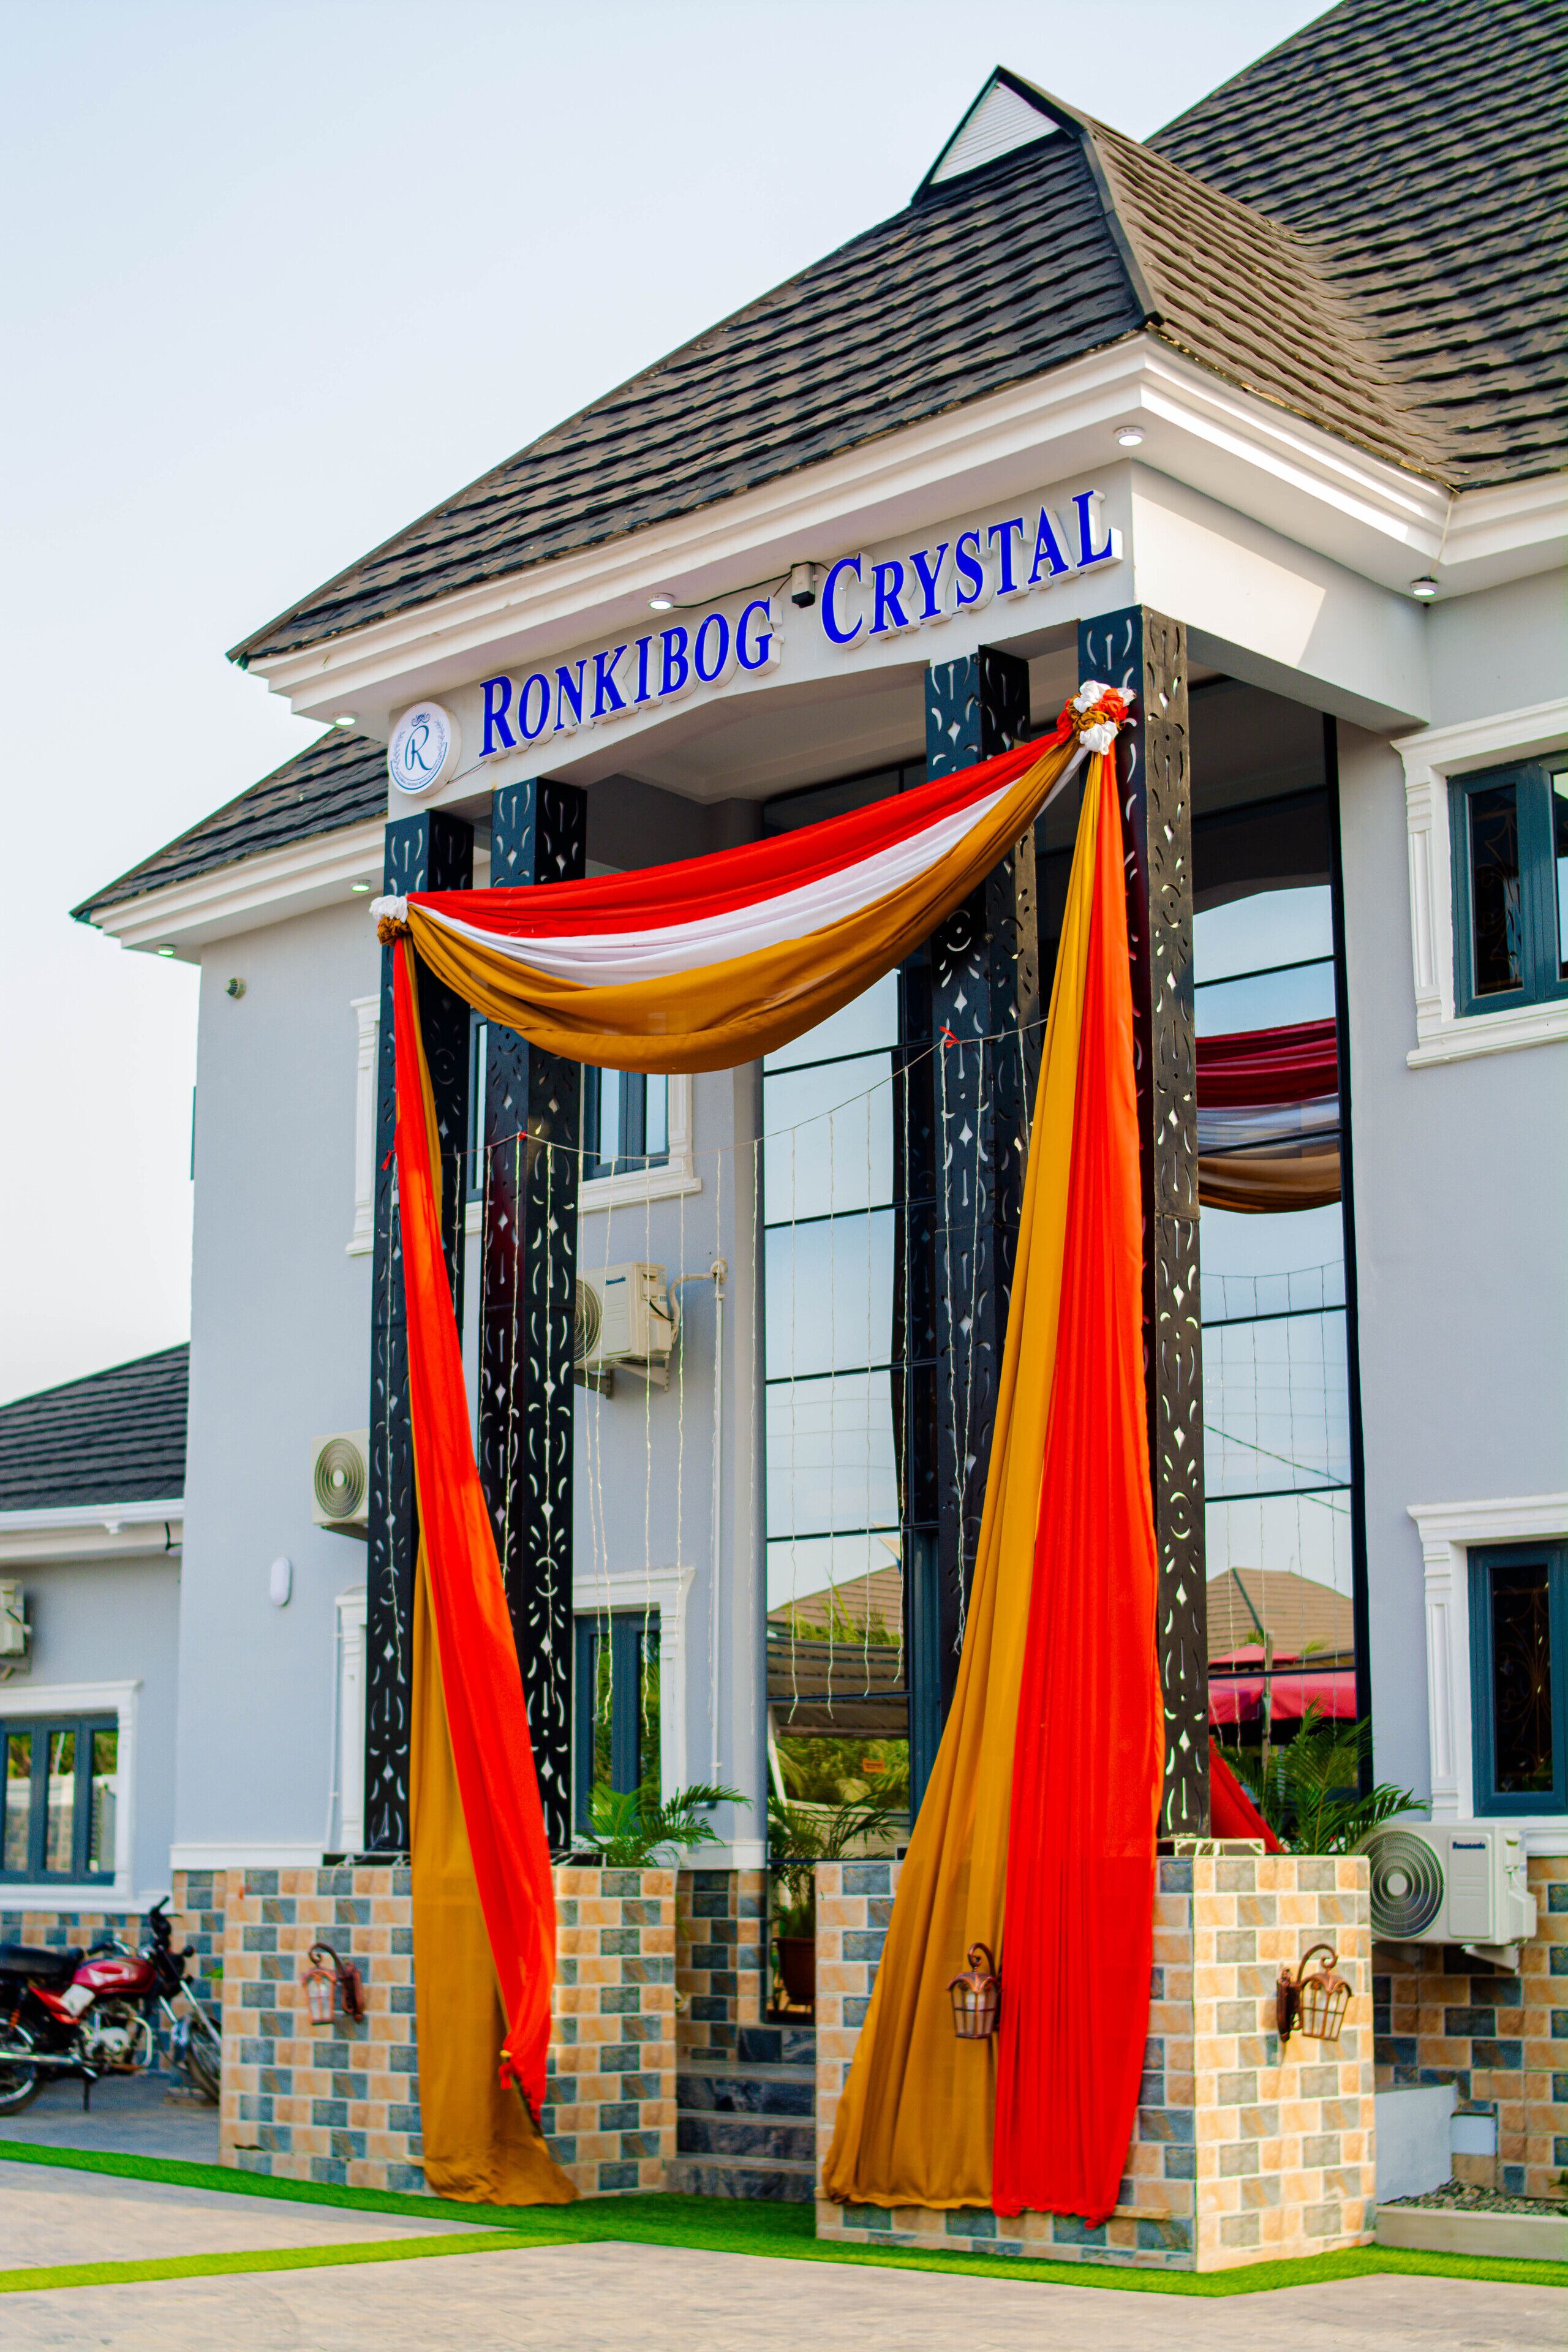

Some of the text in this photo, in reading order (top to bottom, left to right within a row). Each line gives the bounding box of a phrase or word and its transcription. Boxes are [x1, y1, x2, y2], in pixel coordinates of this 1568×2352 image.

[479, 489, 1114, 758] RONKIBOG CRYSTAL
[404, 725, 432, 771] R
